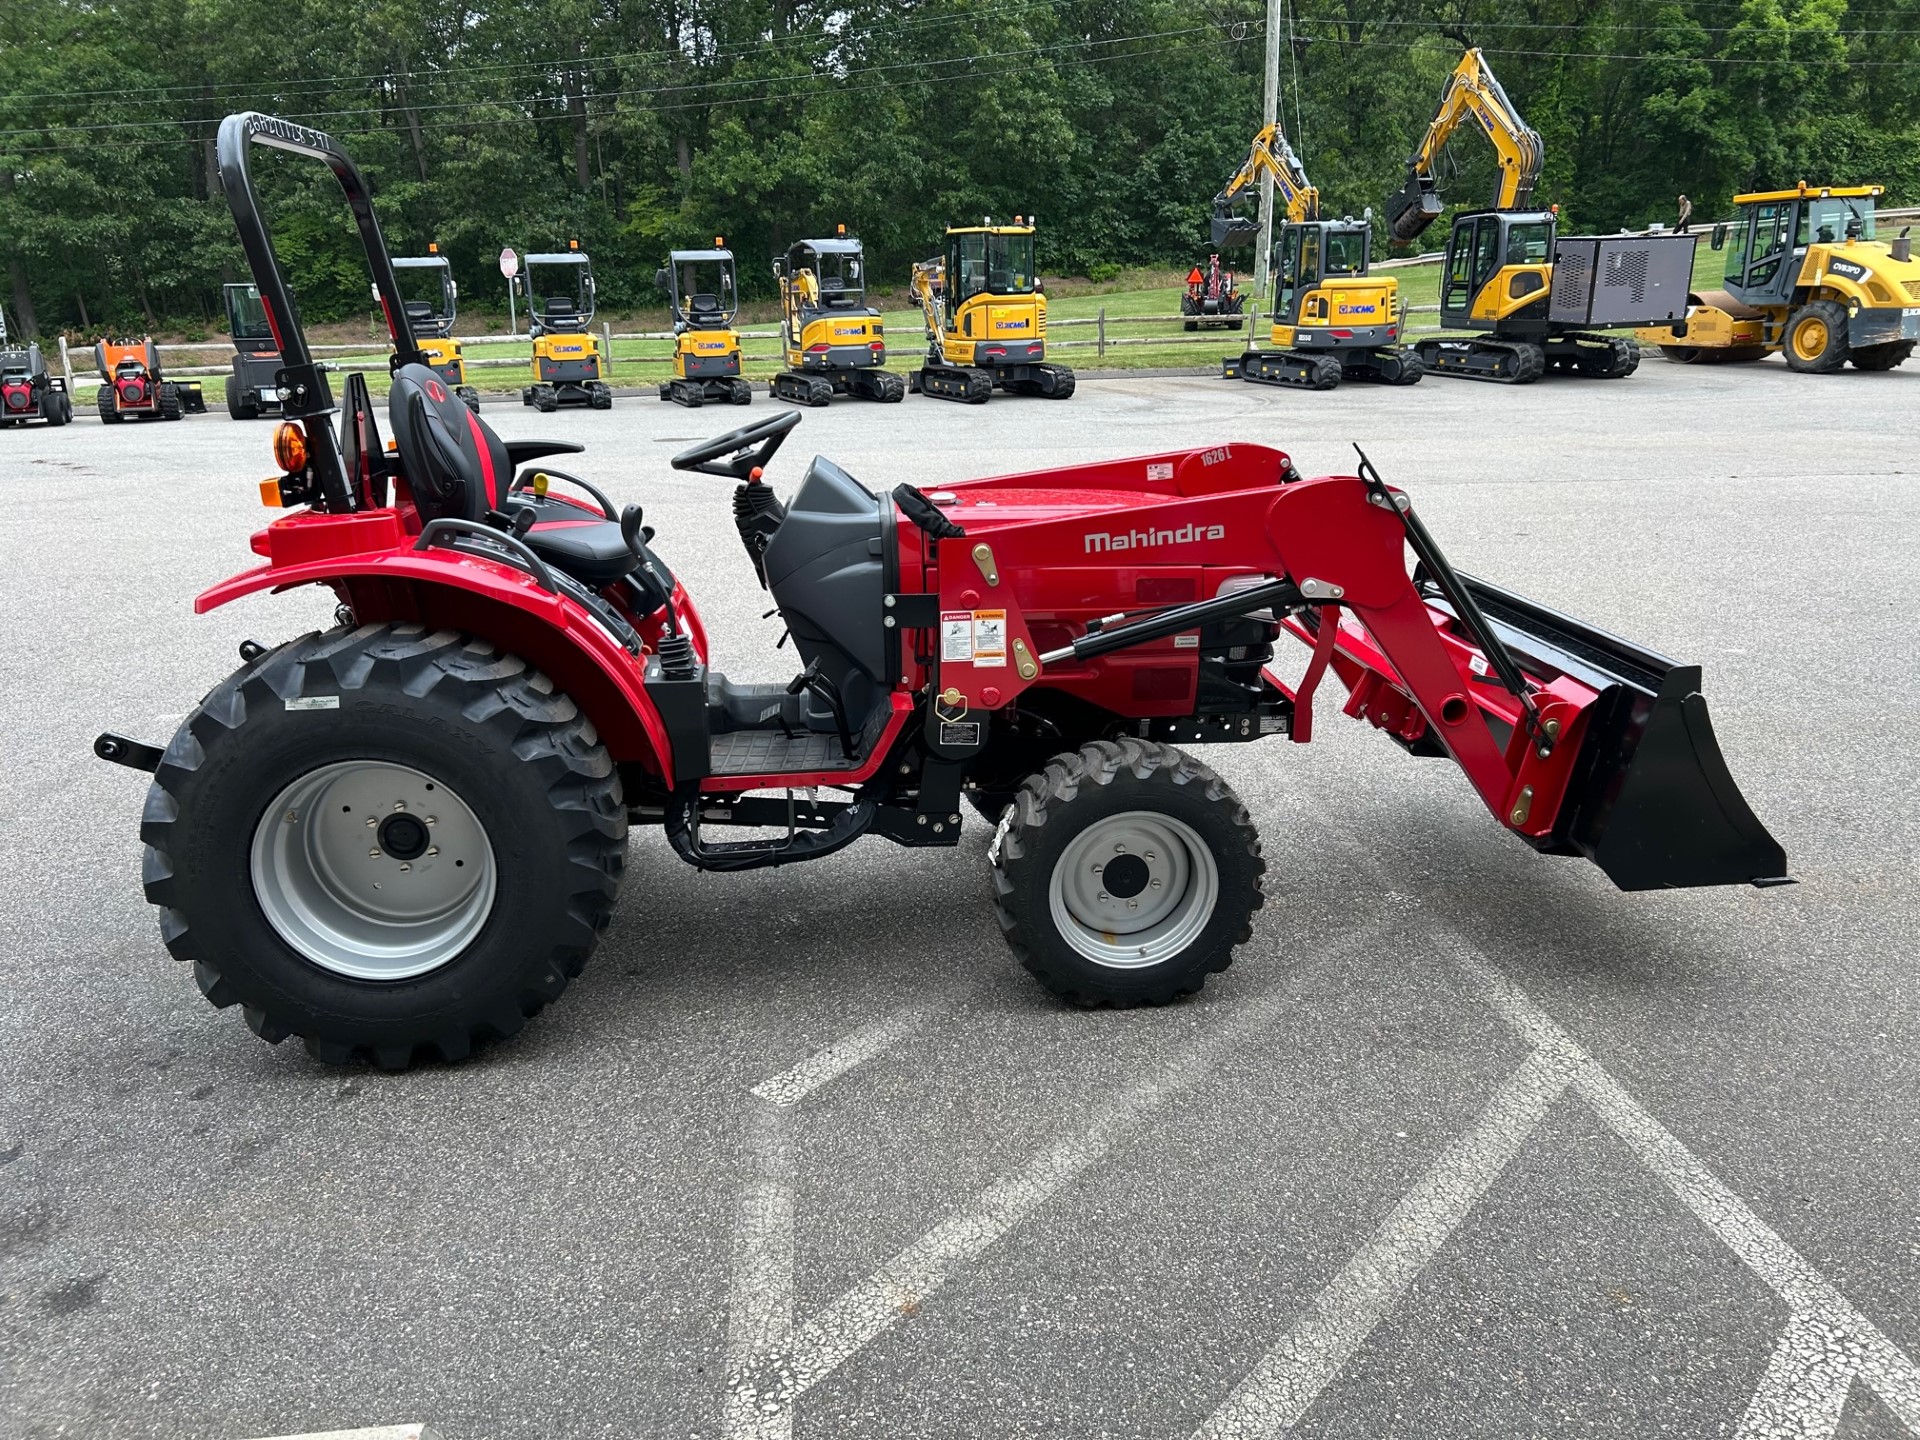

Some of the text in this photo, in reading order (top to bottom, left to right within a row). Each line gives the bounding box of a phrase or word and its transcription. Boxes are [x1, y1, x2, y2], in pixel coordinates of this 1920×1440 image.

[1348, 305, 1376, 314] XCMG
[1200, 446, 1232, 467] 1626 L
[1084, 523, 1225, 553] Mahindra
